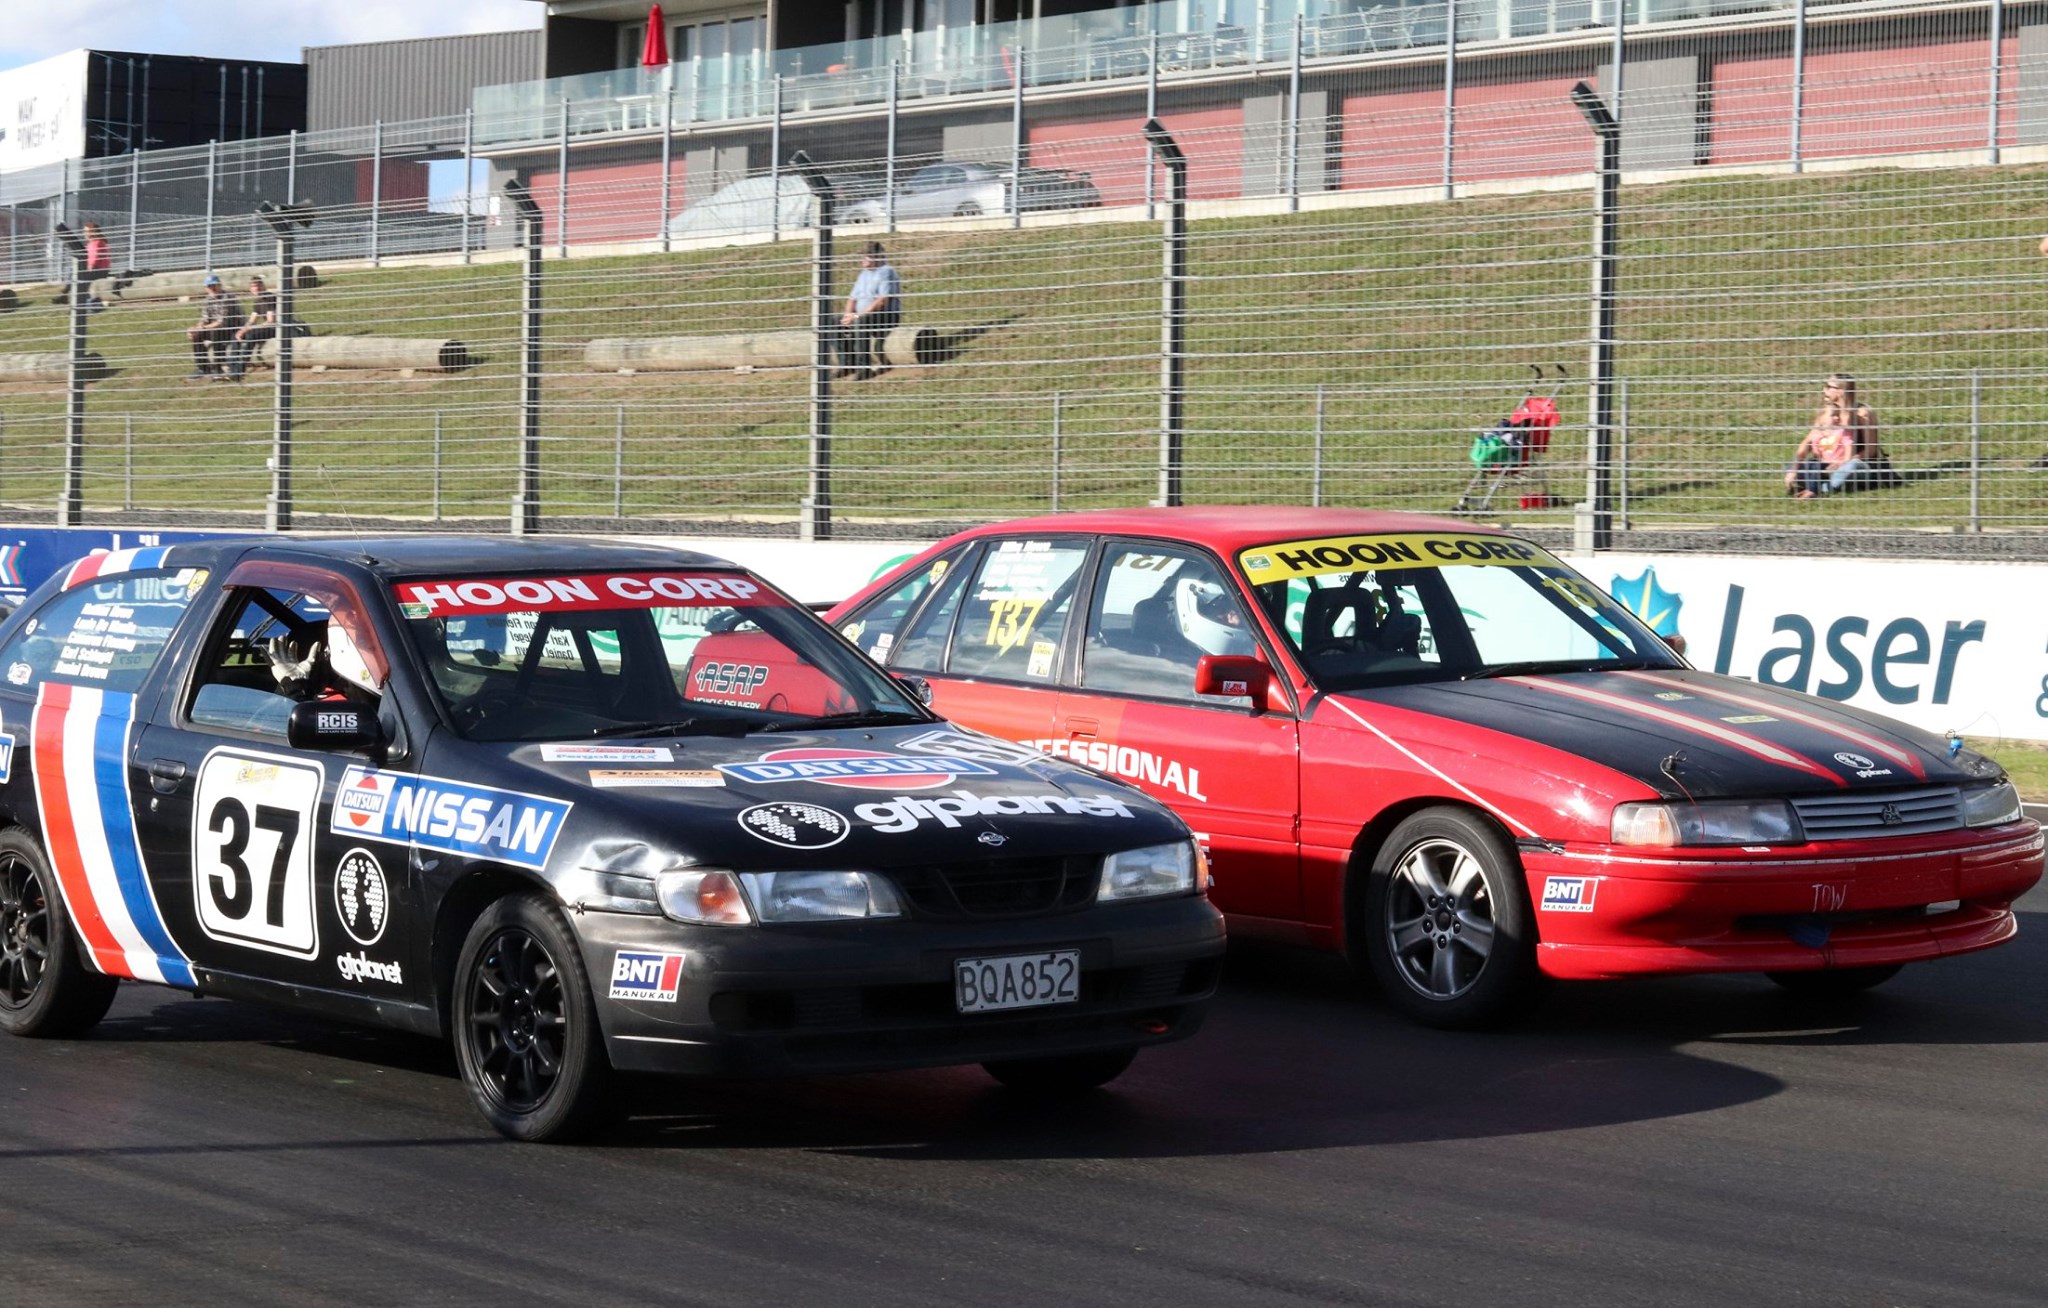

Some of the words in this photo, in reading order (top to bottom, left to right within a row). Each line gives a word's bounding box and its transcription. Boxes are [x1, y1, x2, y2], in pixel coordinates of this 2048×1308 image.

[1277, 541, 1421, 571] HOON
[1424, 540, 1535, 561] CORP
[410, 579, 600, 608] HOON
[606, 577, 759, 600] CORP
[986, 600, 1043, 647] 137
[1714, 583, 1987, 705] Laser
[699, 662, 769, 696] ASAP
[318, 714, 358, 728] RCIS
[743, 757, 970, 780] DATSUN
[343, 789, 382, 813] DATSUN
[392, 786, 553, 854] NISSAN
[208, 796, 300, 928] 37
[1545, 881, 1581, 899] BNT
[614, 958, 661, 983] BNT
[959, 957, 1075, 1007] BQA852
[611, 989, 675, 1000] MANUKAU
